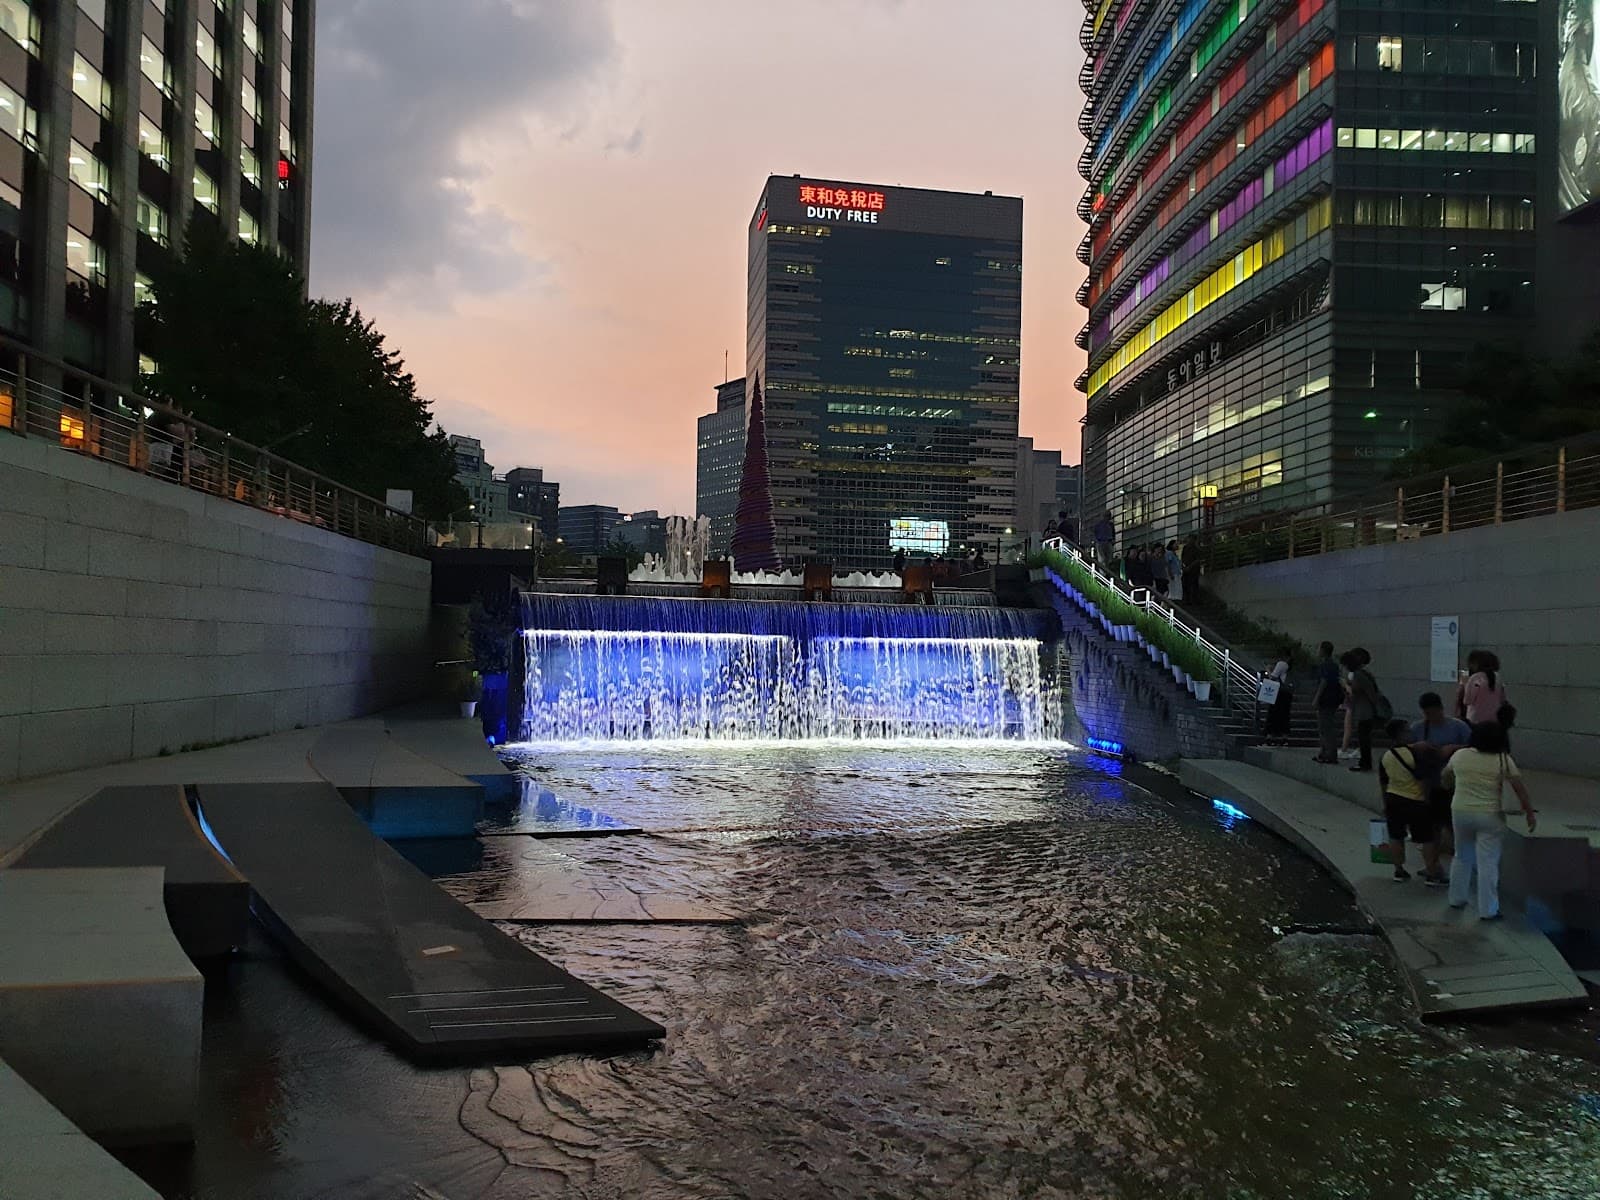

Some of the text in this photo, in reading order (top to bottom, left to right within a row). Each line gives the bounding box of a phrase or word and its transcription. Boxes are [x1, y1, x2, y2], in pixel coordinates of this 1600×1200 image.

[799, 185, 885, 210] 東和免稅店
[807, 206, 878, 224] DUTY FREE
[1166, 341, 1222, 392] 동아일보
